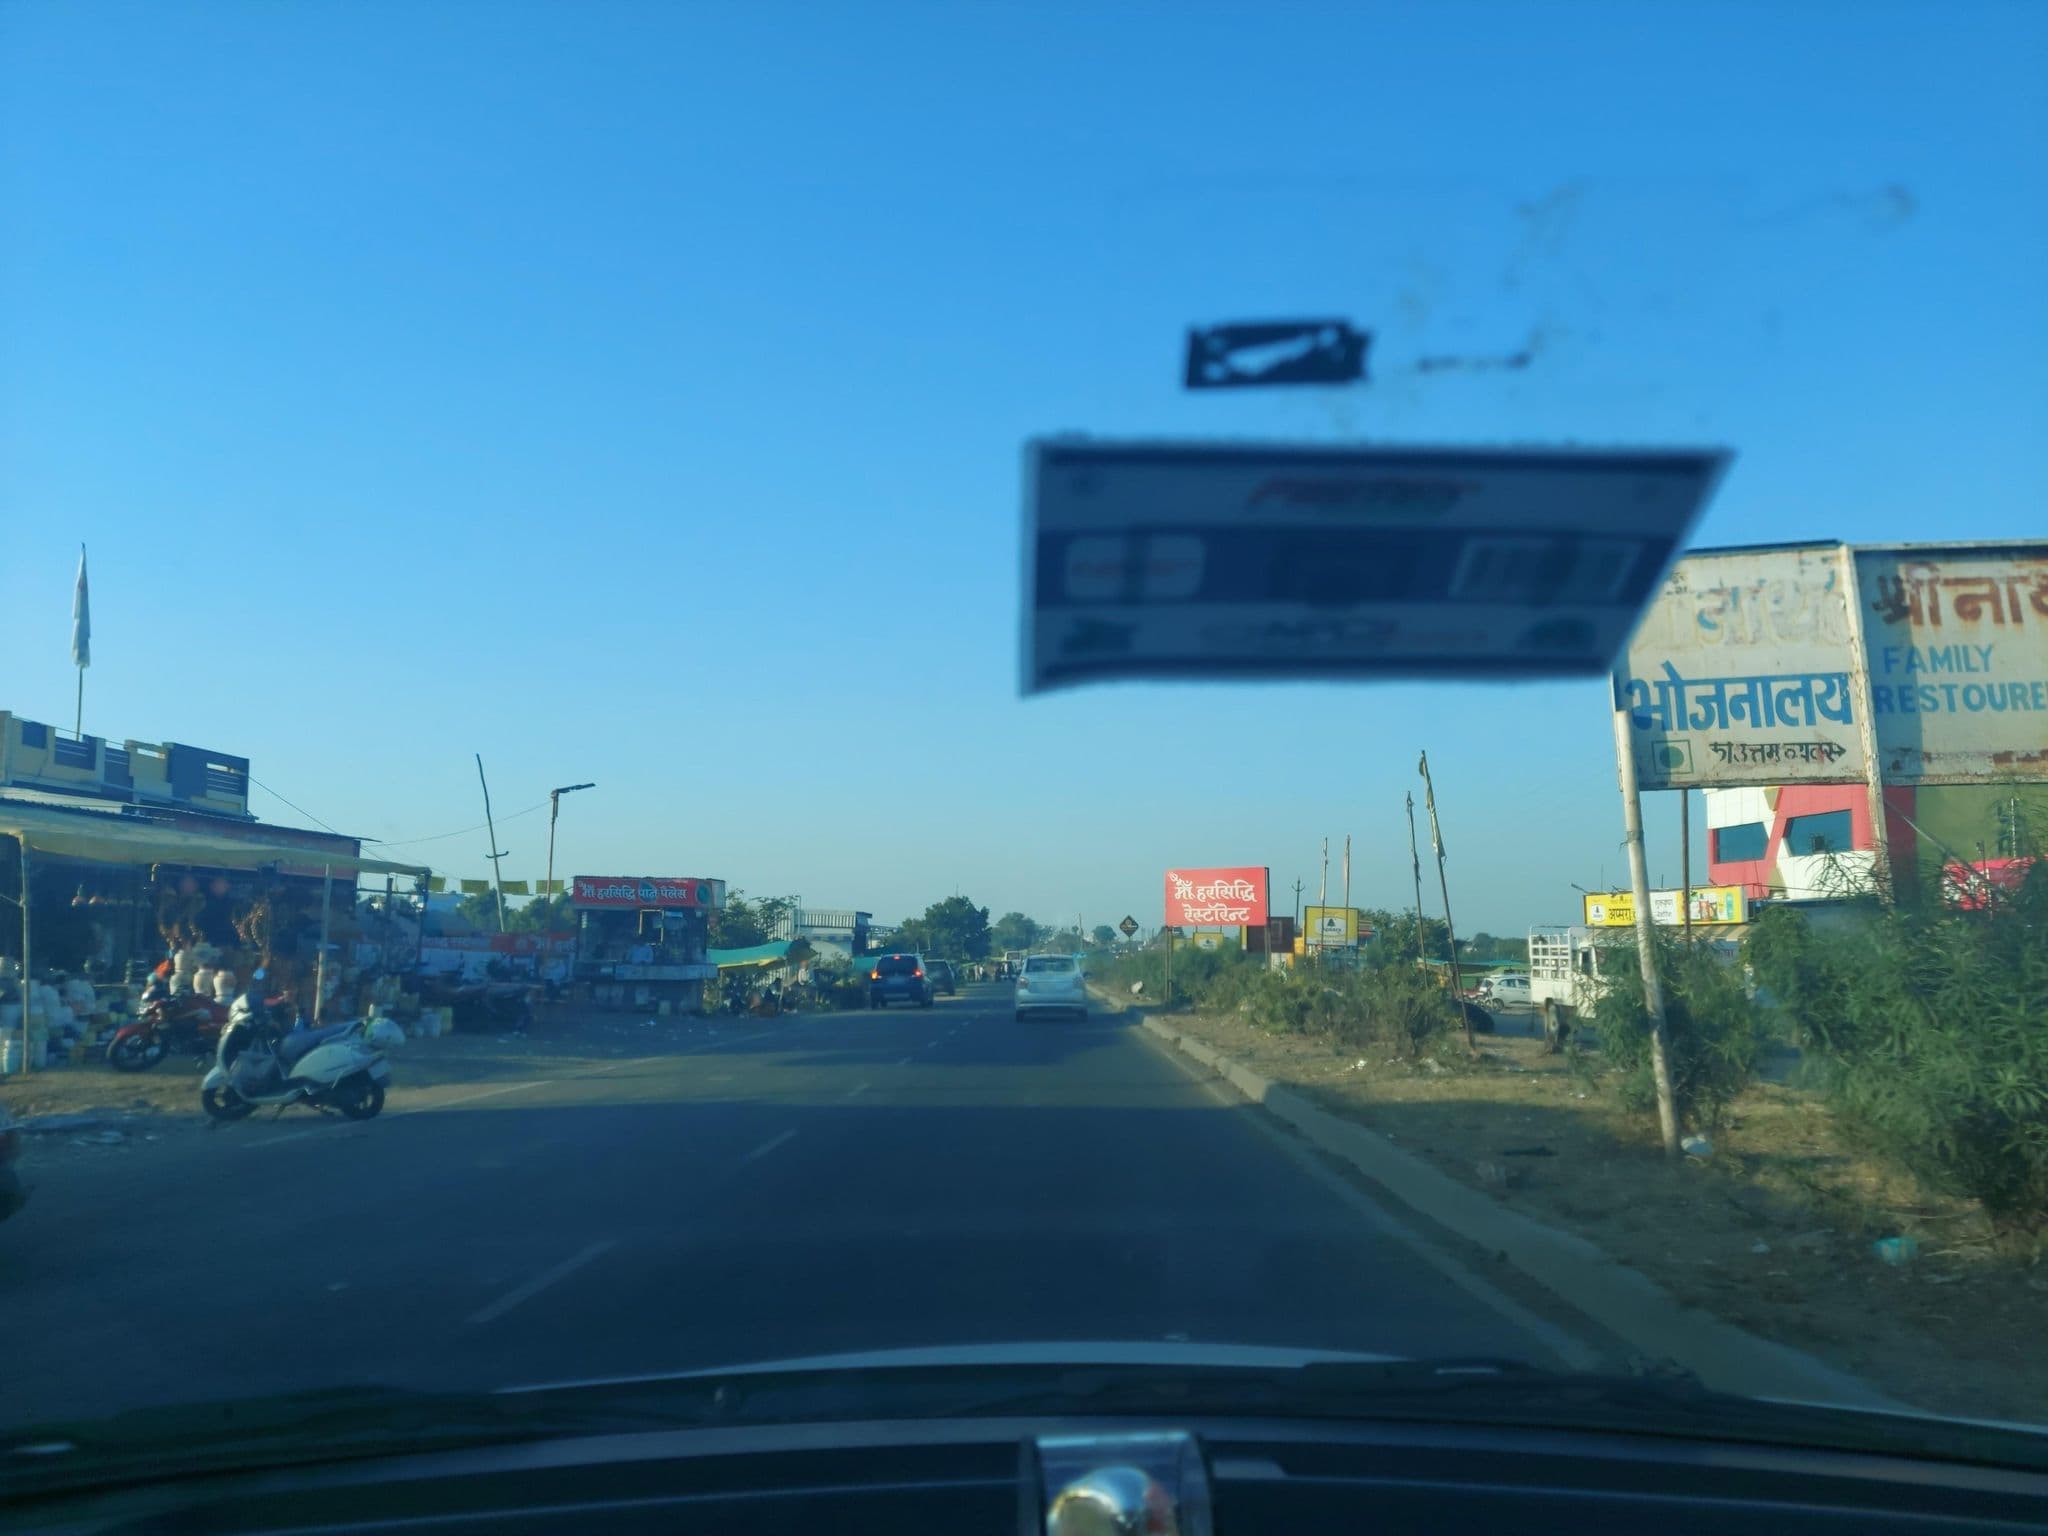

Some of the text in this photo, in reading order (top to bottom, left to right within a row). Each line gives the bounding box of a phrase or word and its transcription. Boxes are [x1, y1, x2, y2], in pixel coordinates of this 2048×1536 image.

[1883, 644, 1994, 675] FAMILY
[1627, 660, 1853, 731] भोजनालय
[1873, 681, 2048, 713] RESTOURE
